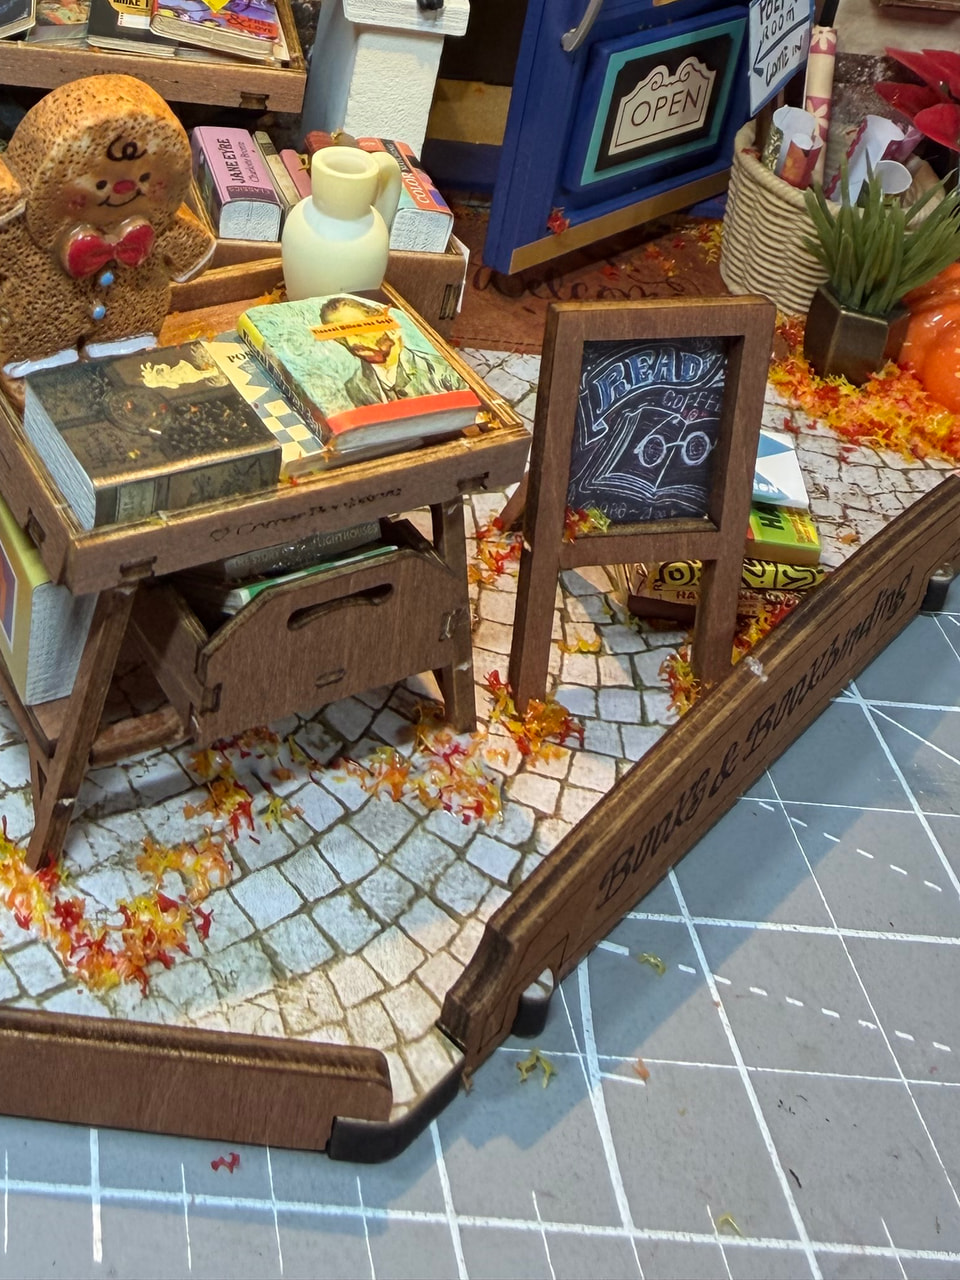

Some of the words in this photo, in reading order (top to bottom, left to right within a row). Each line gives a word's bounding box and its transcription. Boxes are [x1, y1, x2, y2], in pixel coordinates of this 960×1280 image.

[791, 34, 804, 57] IN
[630, 86, 700, 128] OPEN
[216, 137, 237, 160] EYRE
[224, 160, 246, 184] JANE
[401, 171, 430, 204] COLOR
[593, 347, 704, 414] READ
